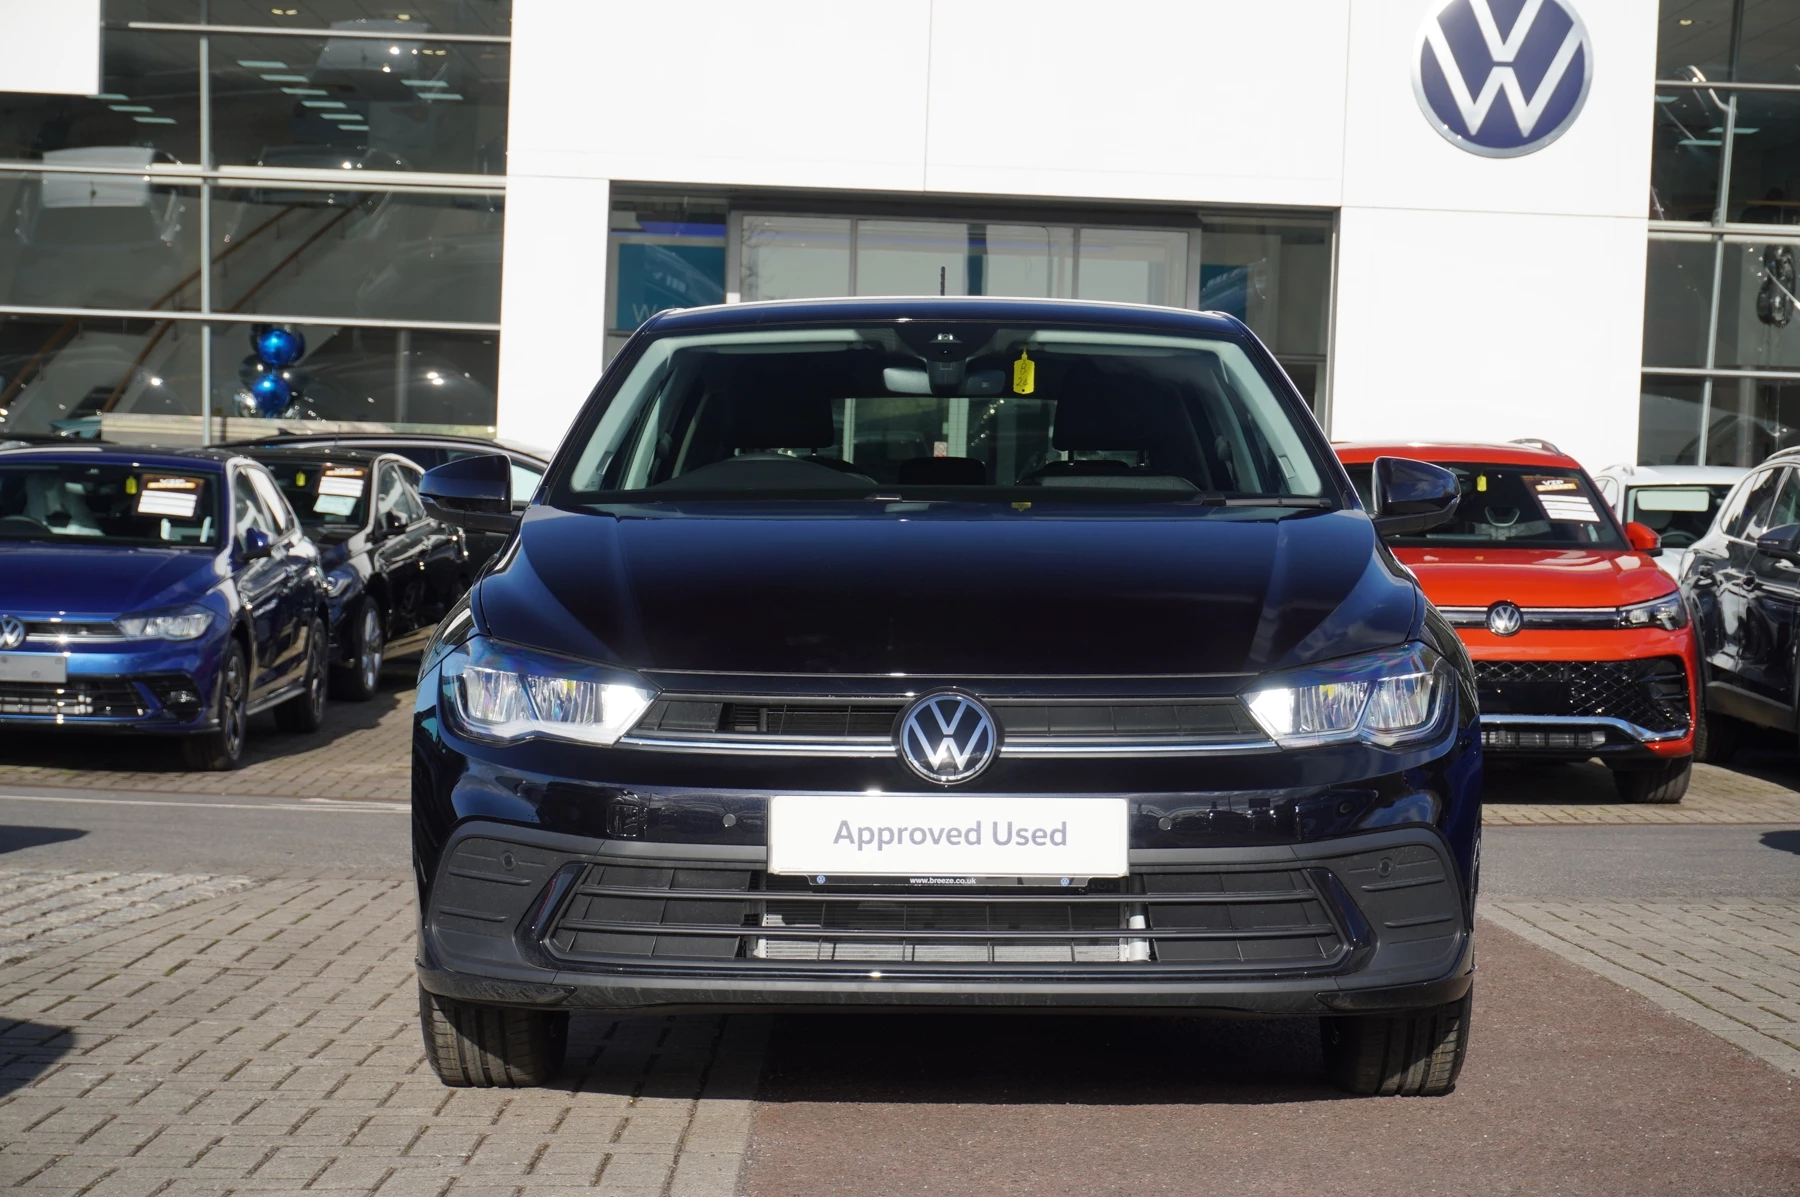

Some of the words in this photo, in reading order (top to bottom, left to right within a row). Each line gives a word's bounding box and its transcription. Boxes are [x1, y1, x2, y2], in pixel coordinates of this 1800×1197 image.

[1420, 0, 1586, 140] VW
[1491, 605, 1520, 632] VW
[905, 696, 992, 774] VW
[833, 820, 982, 851] Approved
[992, 820, 1067, 846] Used
